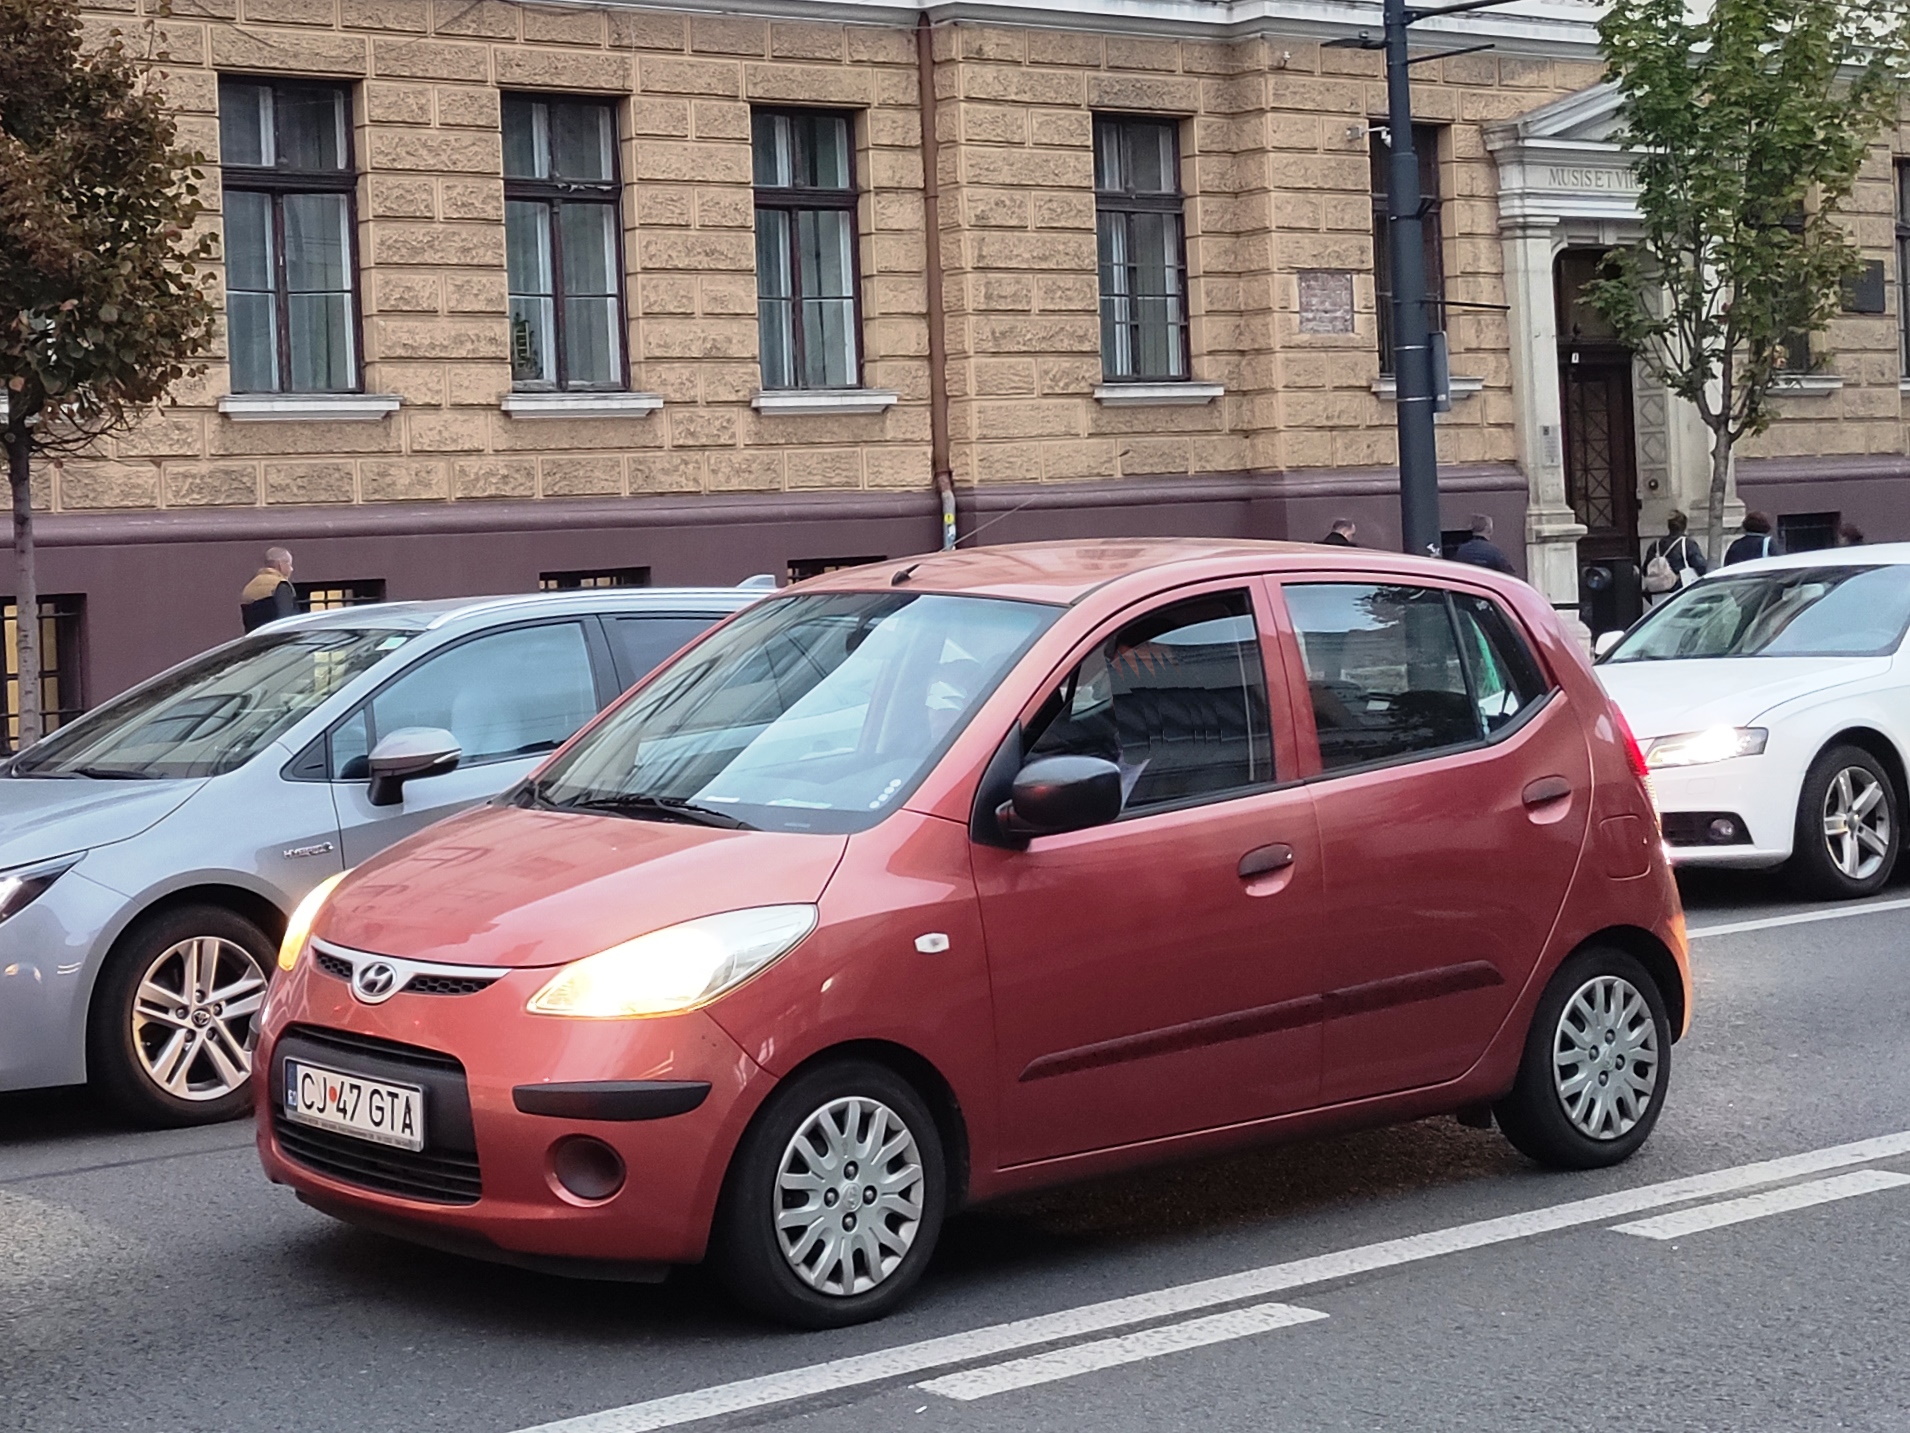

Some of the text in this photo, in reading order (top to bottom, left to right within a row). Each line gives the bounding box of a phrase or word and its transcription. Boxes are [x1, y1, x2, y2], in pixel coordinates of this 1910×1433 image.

[1549, 168, 1592, 187] MUSIS
[1594, 170, 1614, 188] ET
[301, 1073, 328, 1113] CJ
[336, 1081, 362, 1122] 47
[369, 1088, 414, 1136] GTA
